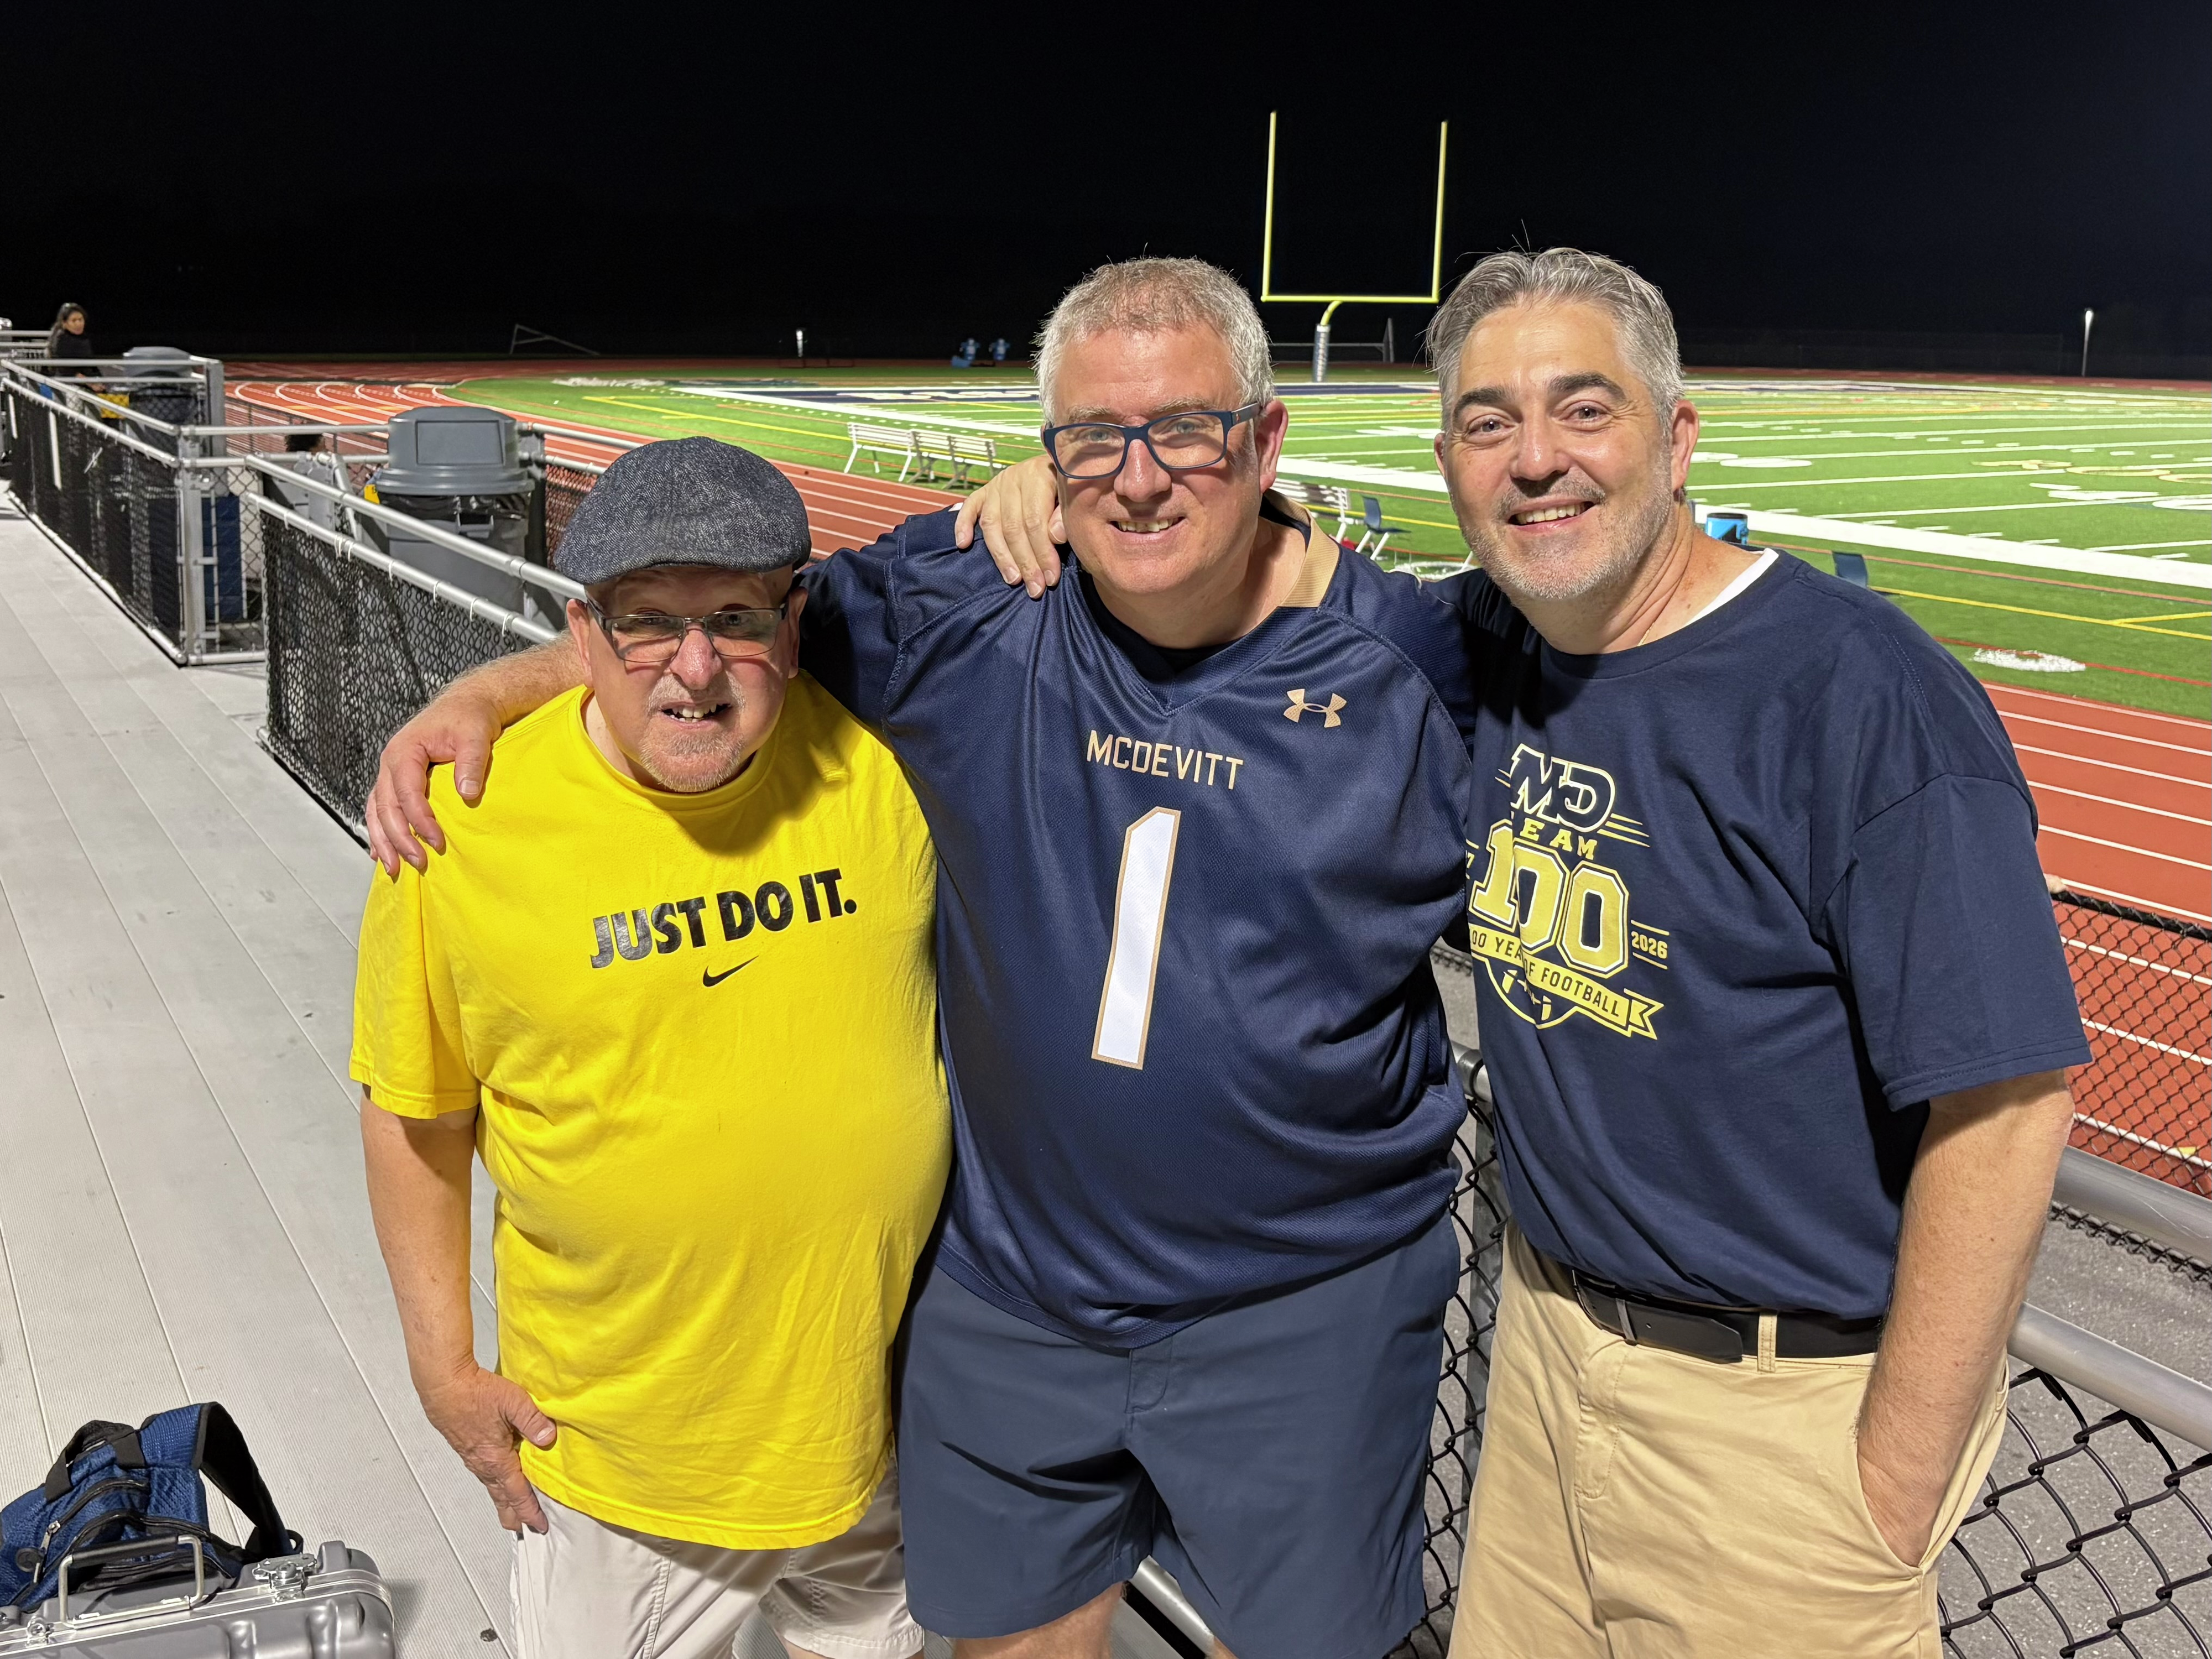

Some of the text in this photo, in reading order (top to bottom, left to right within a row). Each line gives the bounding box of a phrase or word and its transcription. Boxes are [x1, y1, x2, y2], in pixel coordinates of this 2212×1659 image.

[1087, 729, 1244, 790] MCDEVITT
[1511, 811, 1598, 860] EAM
[590, 868, 857, 969] JUST DO IT.
[1091, 806, 1181, 1071] 1
[1468, 818, 1629, 979] 100
[1472, 930, 1487, 948] 00
[1495, 936, 1522, 961] YEA
[1541, 967, 1620, 1017] FOOTBALL
[1630, 931, 1668, 959] 2026
